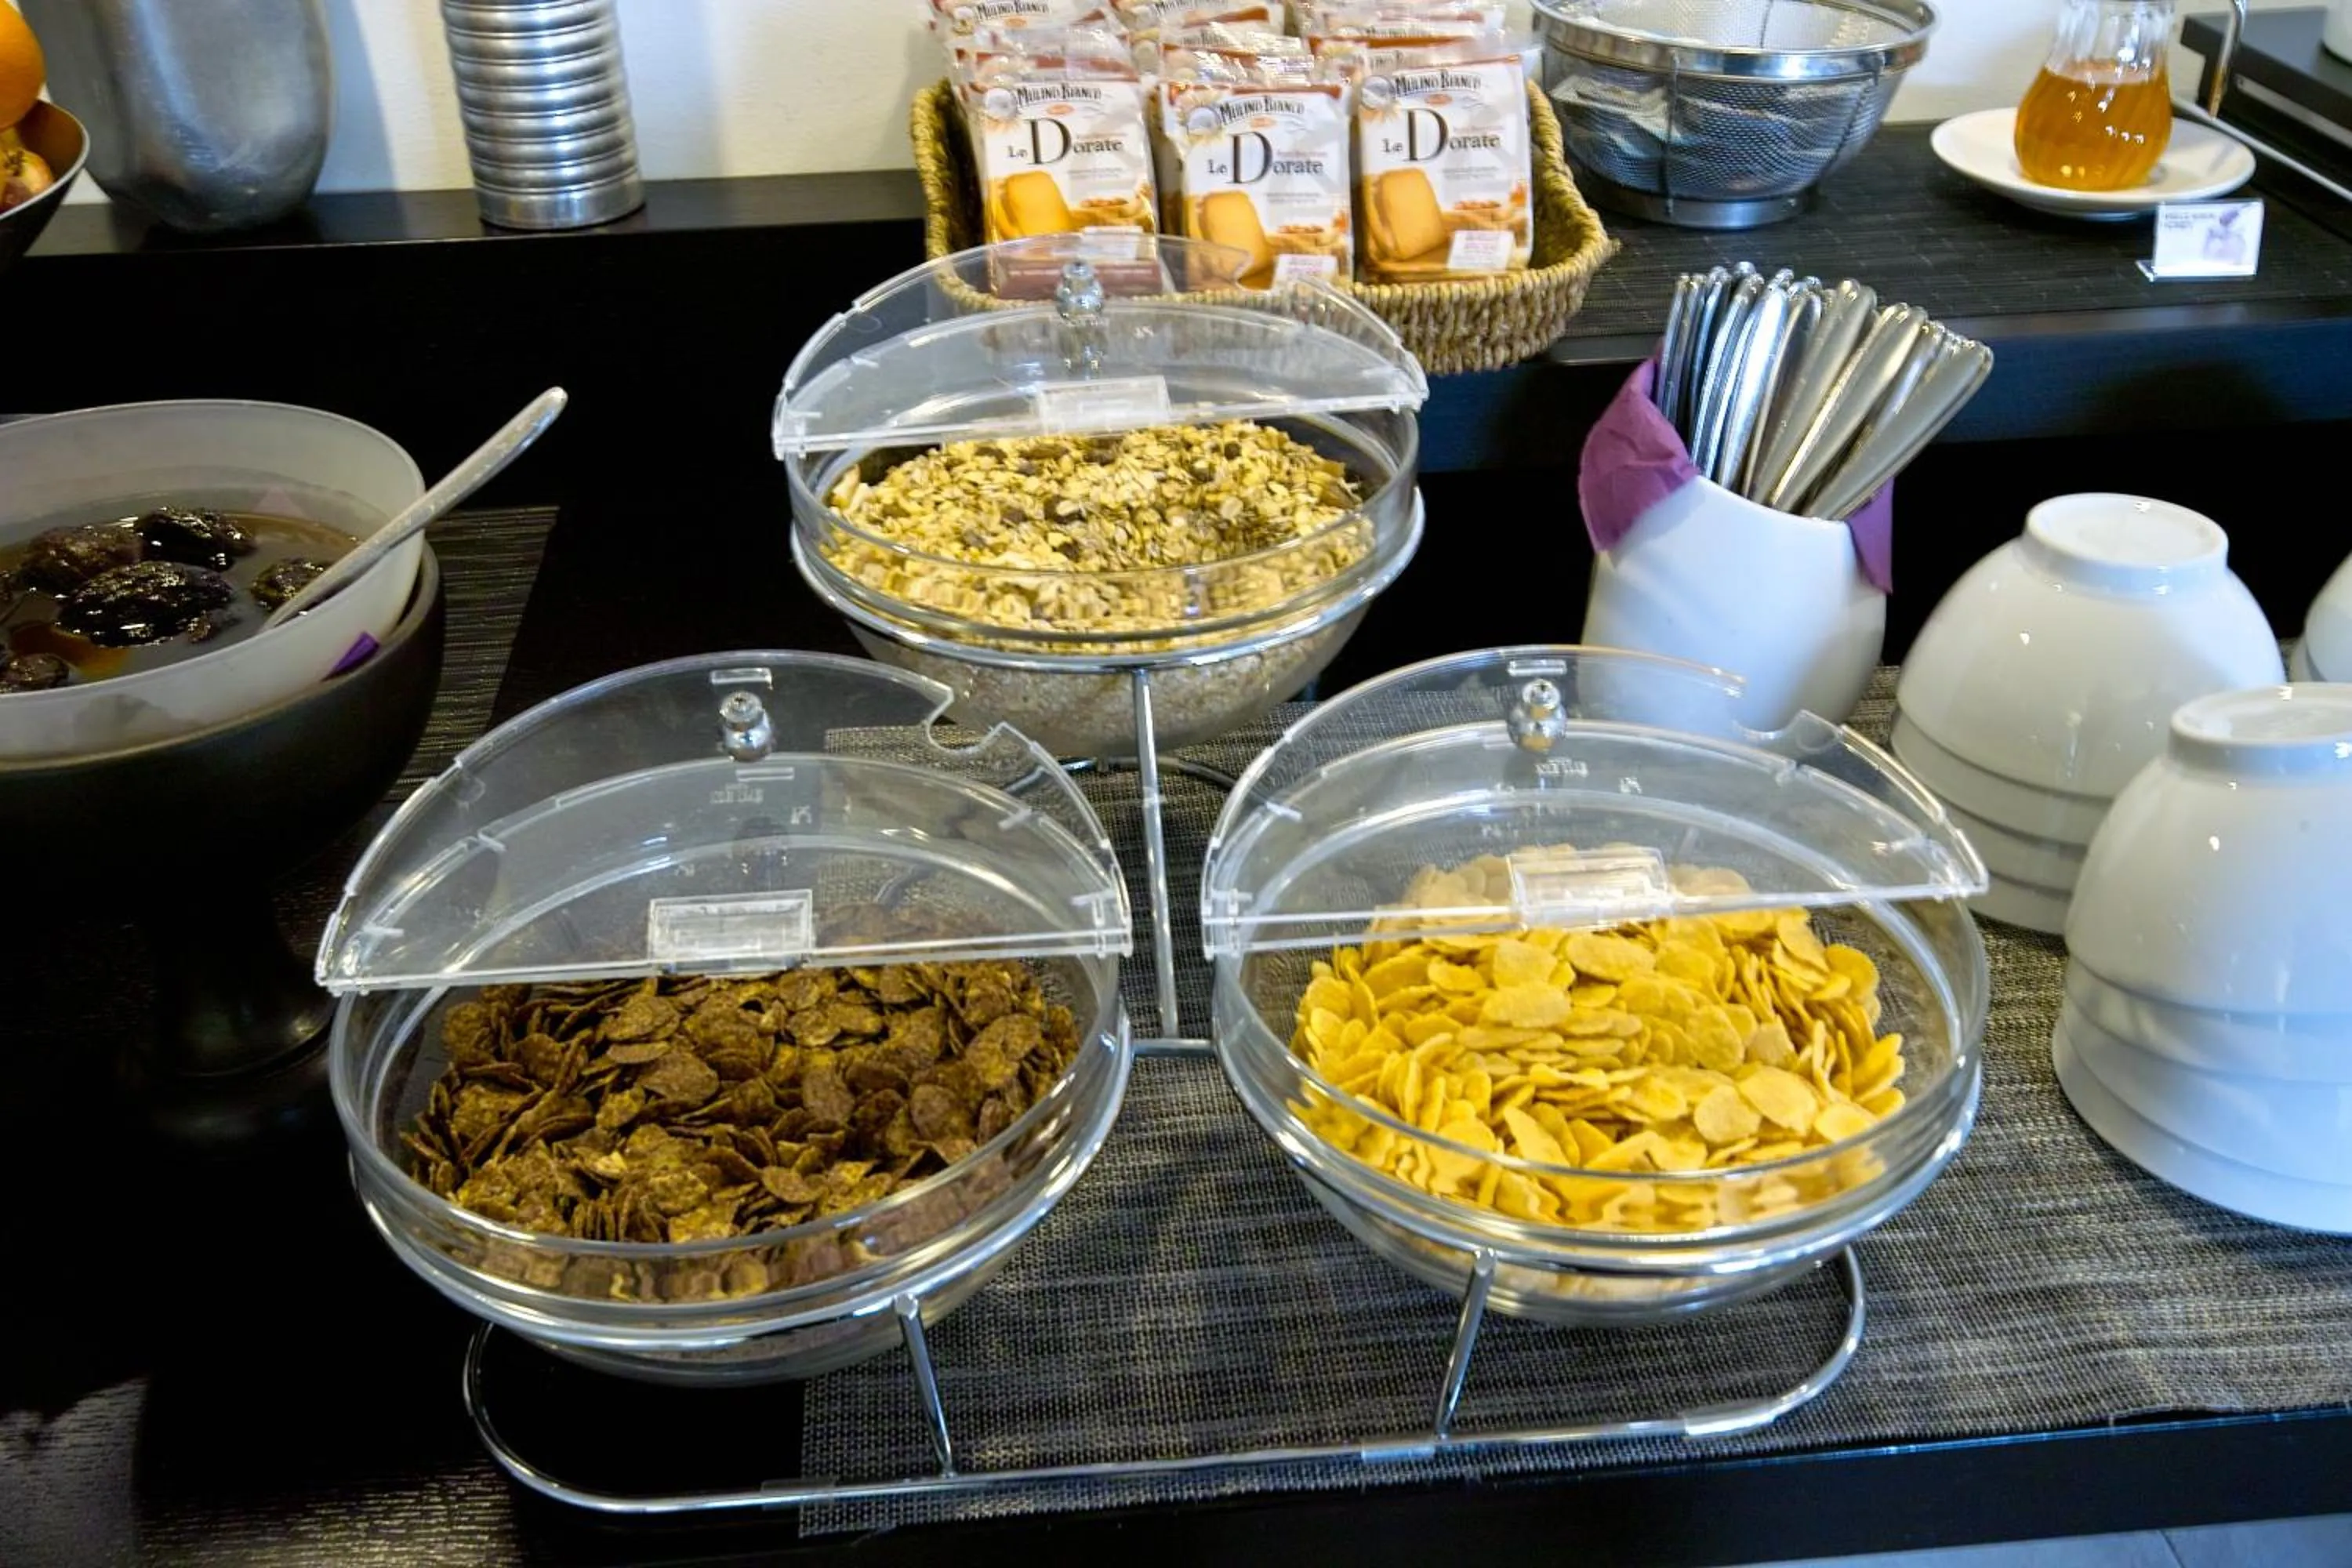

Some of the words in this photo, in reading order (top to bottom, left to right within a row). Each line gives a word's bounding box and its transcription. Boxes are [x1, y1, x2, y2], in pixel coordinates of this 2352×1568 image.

[1007, 144, 1029, 158] Le
[1024, 117, 1123, 165] Dorate
[1207, 158, 1229, 175] Le
[1225, 131, 1324, 183] Dorate
[1381, 137, 1403, 153] Le
[1402, 107, 1501, 162] Dorate
